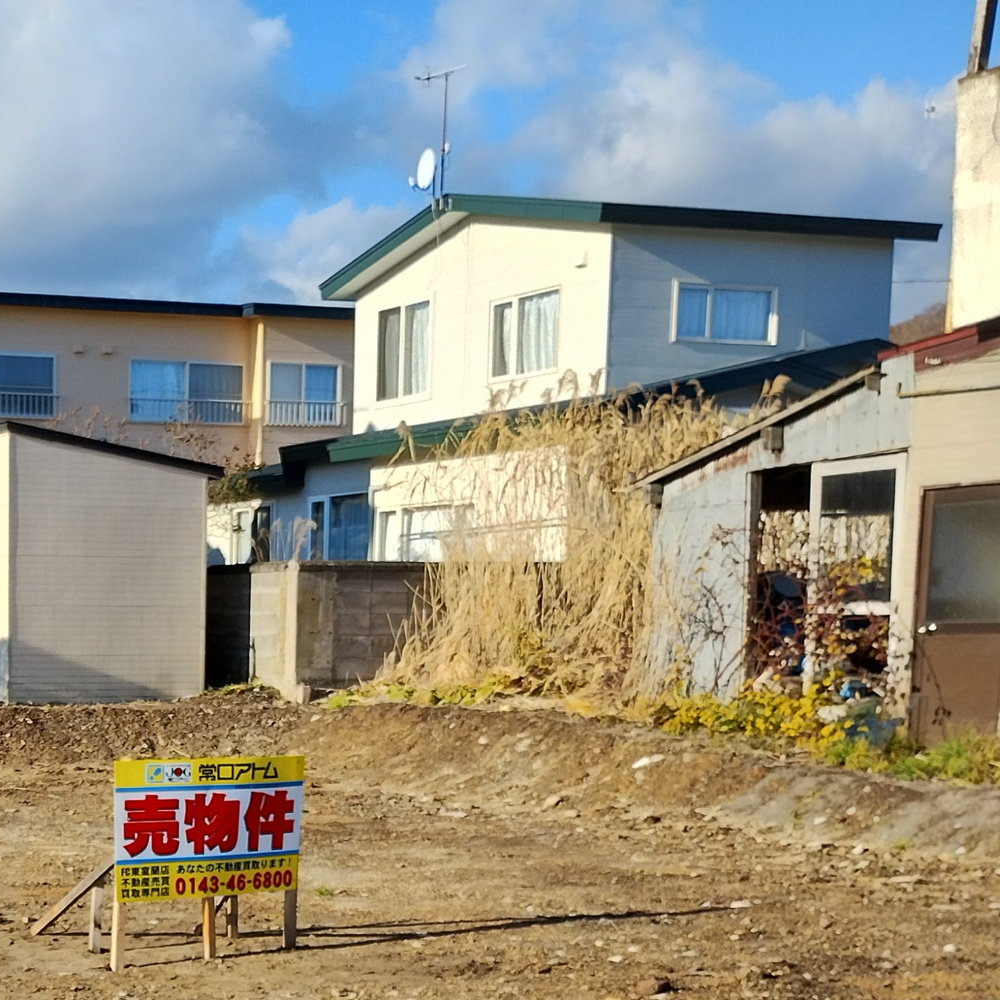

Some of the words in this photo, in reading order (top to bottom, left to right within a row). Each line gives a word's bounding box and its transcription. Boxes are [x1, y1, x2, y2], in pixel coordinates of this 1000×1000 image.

[199, 762, 278, 781] 常口アトム
[123, 790, 295, 858] 売物件
[121, 876, 170, 888] 不動産売買
[175, 870, 293, 895] 0143-46-6800
